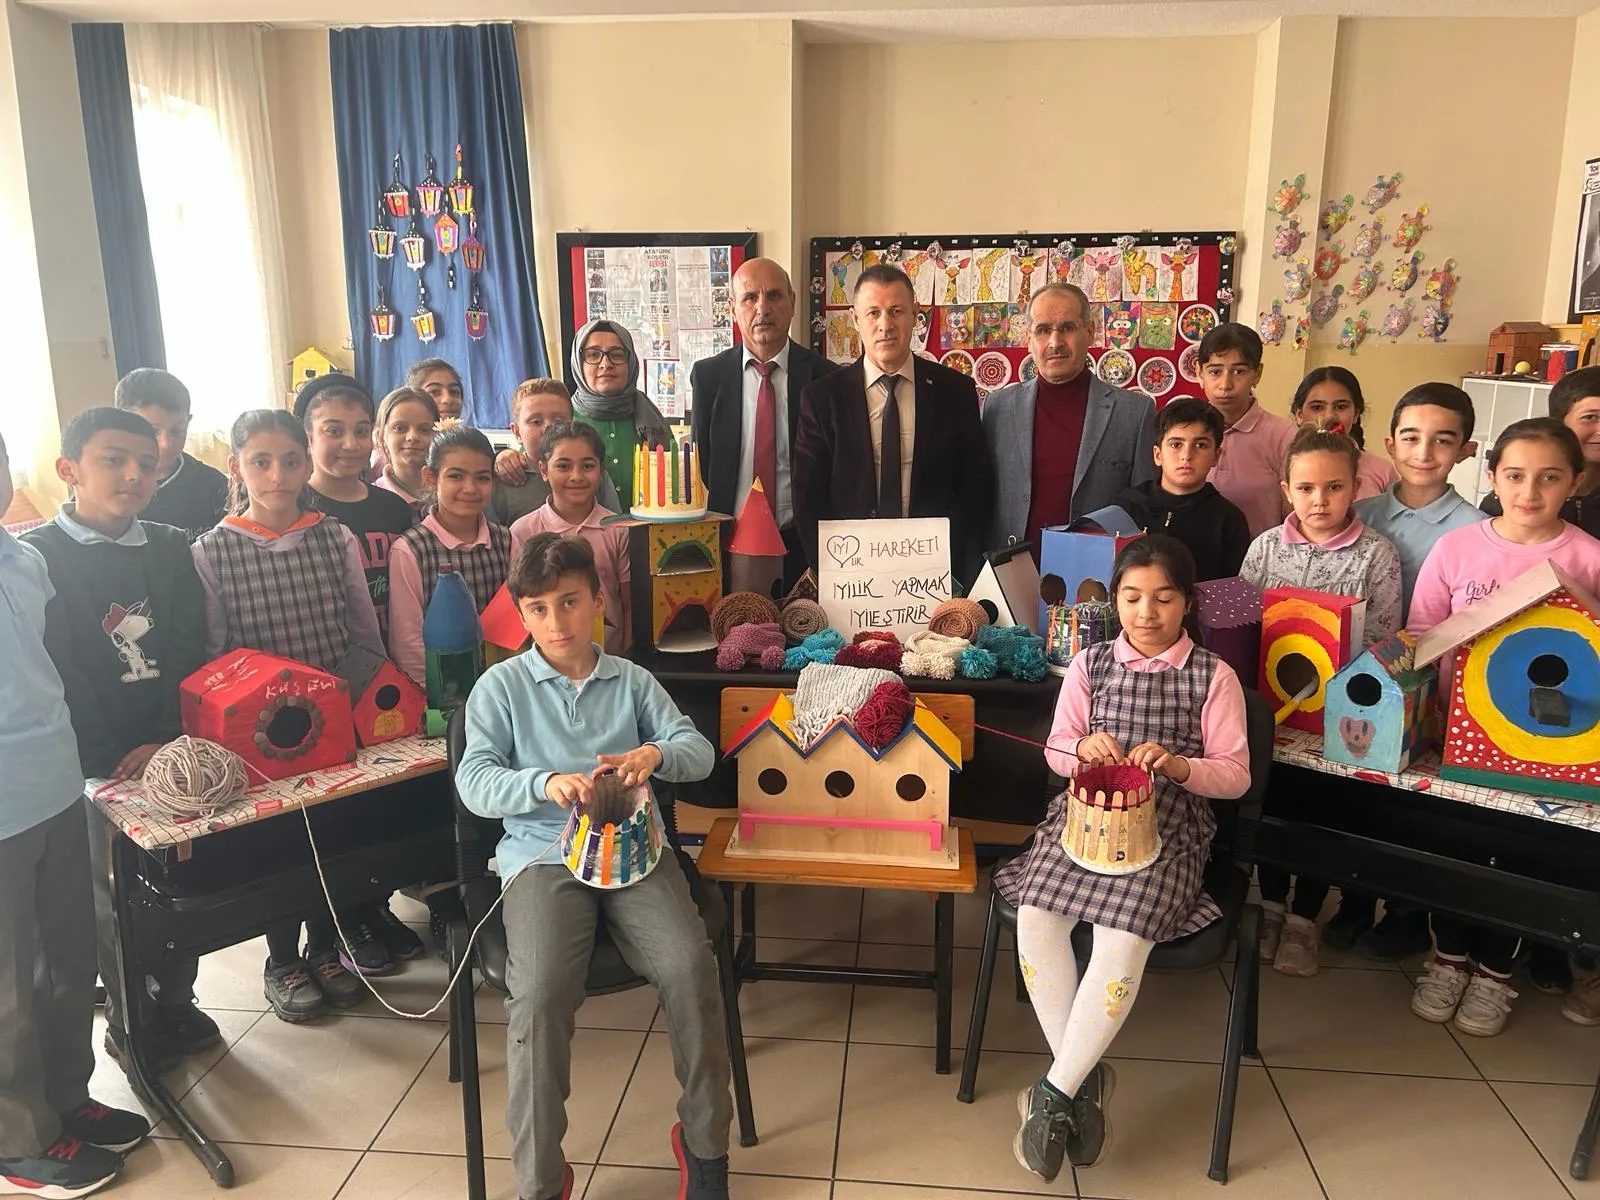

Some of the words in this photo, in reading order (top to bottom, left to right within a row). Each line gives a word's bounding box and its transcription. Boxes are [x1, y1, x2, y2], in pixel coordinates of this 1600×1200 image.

[870, 536, 939, 558] HAREKETİ
[833, 577, 884, 600] İYİLİK
[892, 570, 950, 602] YAPMAK
[850, 604, 932, 628] İYİLEŞTİRİR
